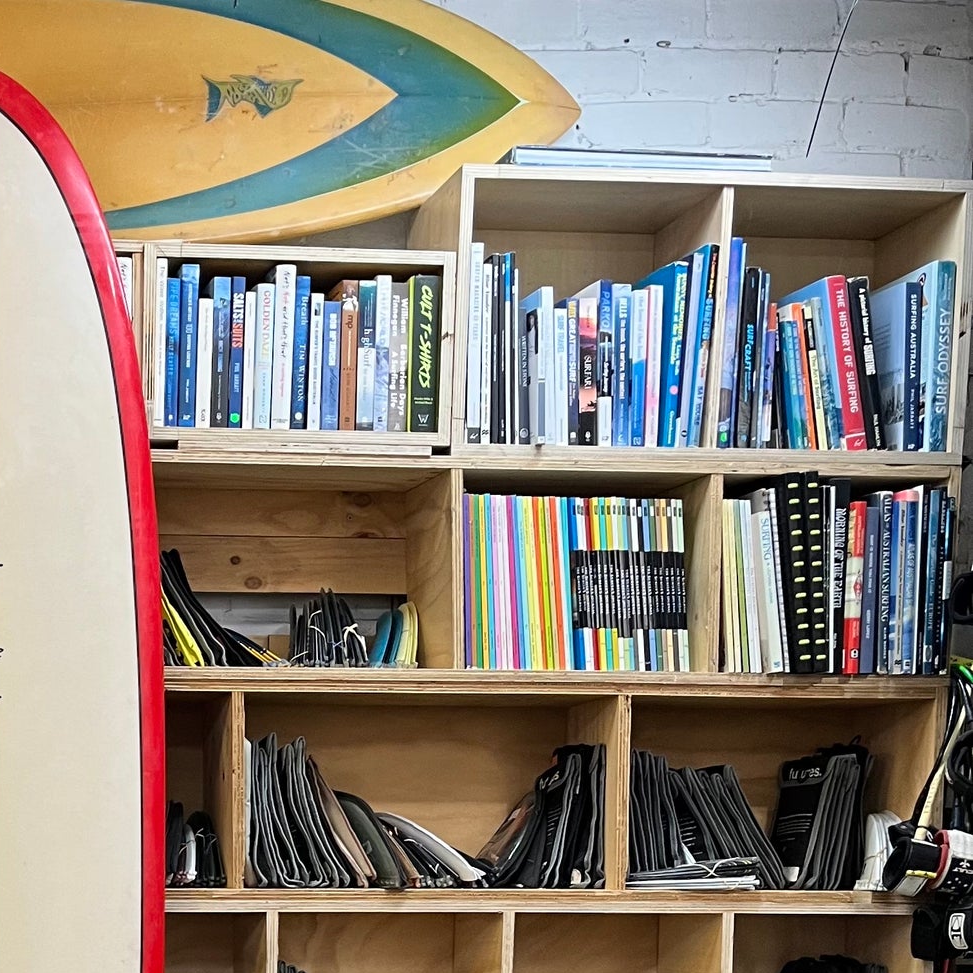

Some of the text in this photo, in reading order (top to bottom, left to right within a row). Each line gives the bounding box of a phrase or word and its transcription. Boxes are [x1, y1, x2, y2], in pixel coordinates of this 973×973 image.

[169, 281, 178, 334] PIPE DREAMS
[232, 292, 245, 348] SALTS SUITS
[300, 296, 308, 325] Breath
[346, 315, 353, 328] mp
[602, 291, 610, 328] PARKO
[702, 298, 713, 340] SURFING
[859, 294, 868, 316] pictorial
[418, 285, 433, 388] CULT T-SHIRTS
[835, 289, 858, 413] THE HISTORY OF SURFING
[937, 308, 950, 376] ODYSSEY
[863, 344, 876, 376] SURFING
[935, 378, 948, 414] SURF
[761, 518, 771, 560] SURFING
[833, 508, 847, 608] MORNING OF THE EARTH
[881, 496, 892, 622] ATLAS AUSTRALIAN SURFING
